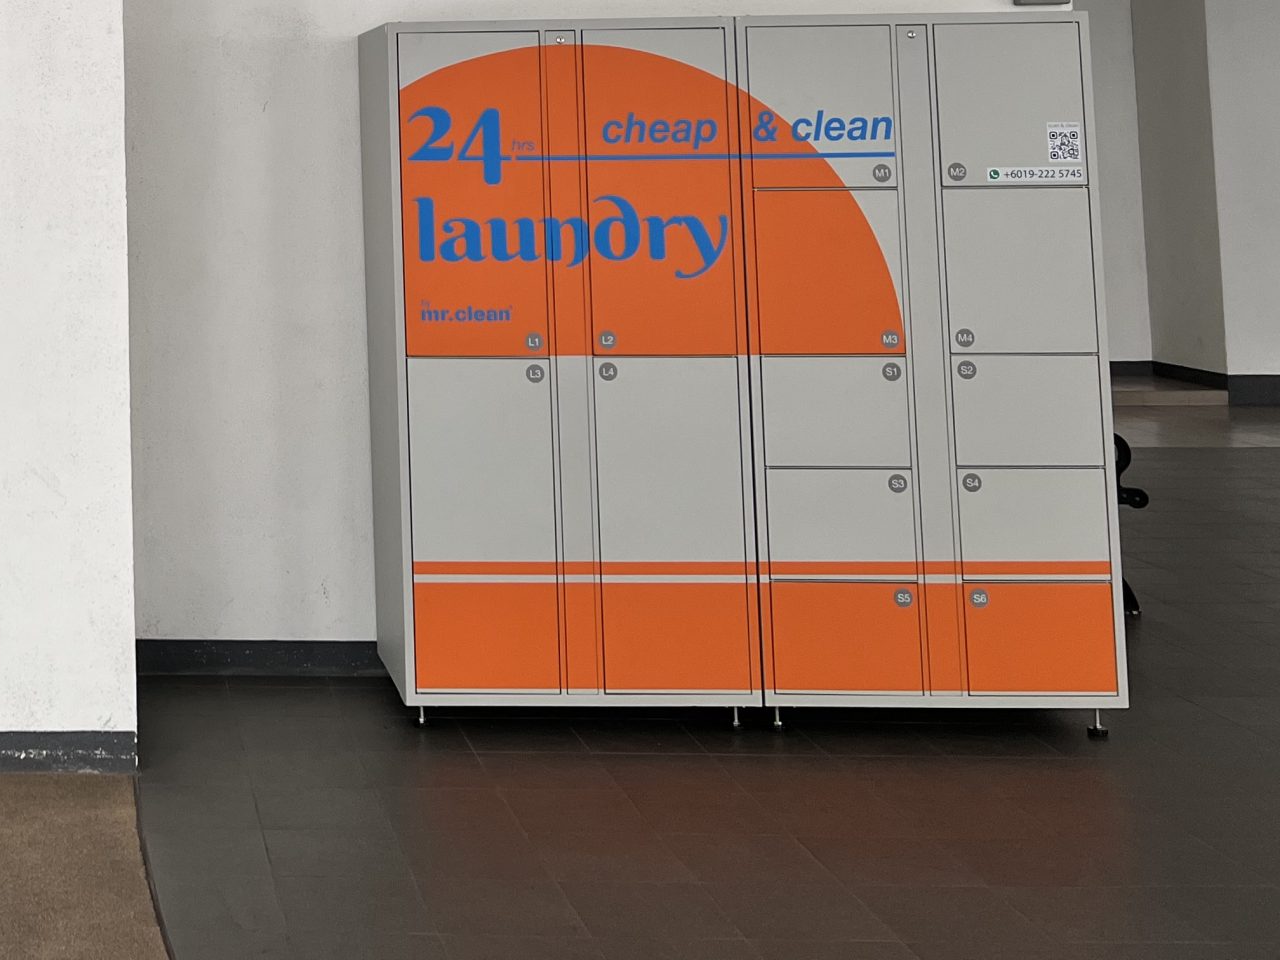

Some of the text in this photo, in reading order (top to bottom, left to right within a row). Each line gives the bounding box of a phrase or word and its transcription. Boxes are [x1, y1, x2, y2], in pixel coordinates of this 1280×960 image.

[602, 109, 893, 150] cheap & clean
[407, 106, 535, 185] 24 hrs
[875, 169, 889, 178] M1
[950, 168, 965, 177] M2
[1004, 168, 1082, 179] +6019-222 5745
[412, 195, 729, 279] laundry
[421, 305, 511, 322] mr.clean
[528, 337, 539, 346] L1
[602, 336, 613, 345] L2
[883, 335, 898, 344] M3
[958, 333, 972, 342] M4
[530, 369, 541, 378] L3
[603, 367, 614, 376] L4
[886, 367, 896, 376] S1
[961, 365, 973, 374] S2
[892, 479, 904, 488] S3
[967, 478, 979, 487] S4
[897, 593, 910, 602] S5
[973, 594, 986, 603] S6
